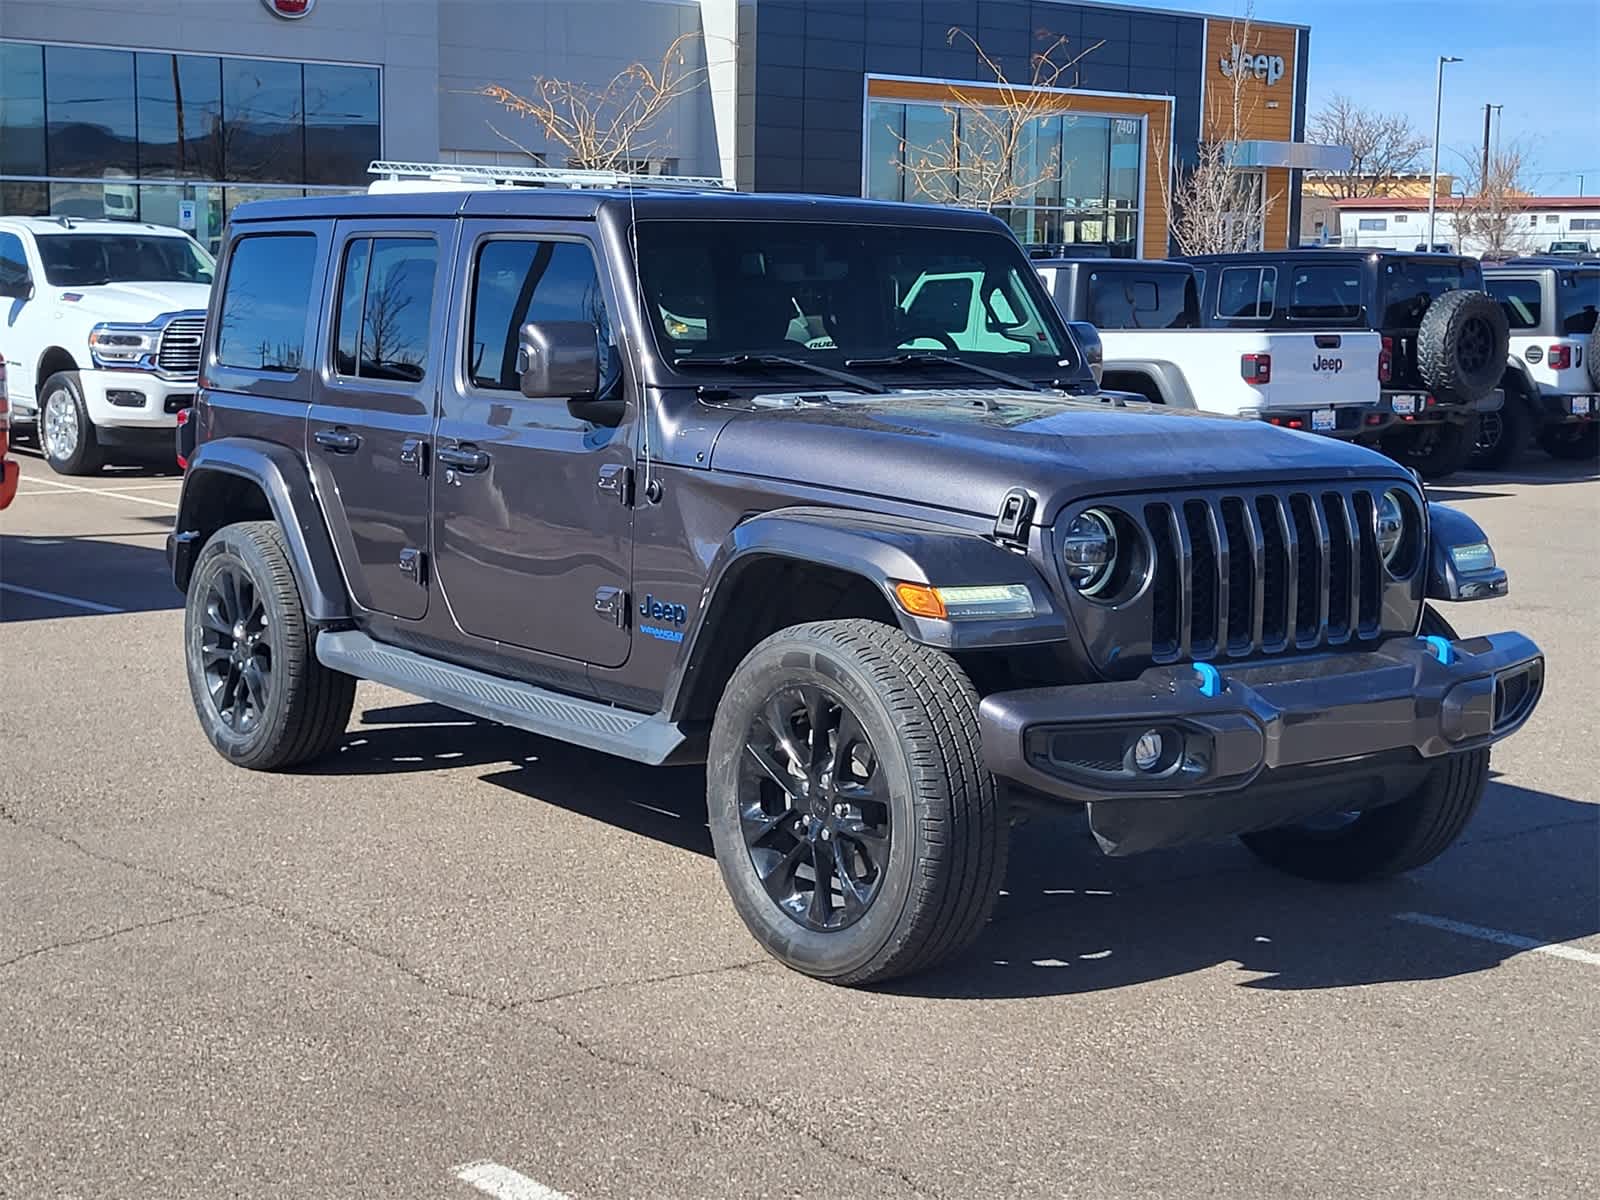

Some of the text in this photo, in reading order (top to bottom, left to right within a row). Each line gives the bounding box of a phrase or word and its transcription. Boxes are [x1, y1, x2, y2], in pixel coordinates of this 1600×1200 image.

[1220, 44, 1285, 86] Jeep
[1115, 119, 1136, 135] 7401
[1312, 355, 1343, 374] Jeep
[639, 593, 687, 627] Jeep
